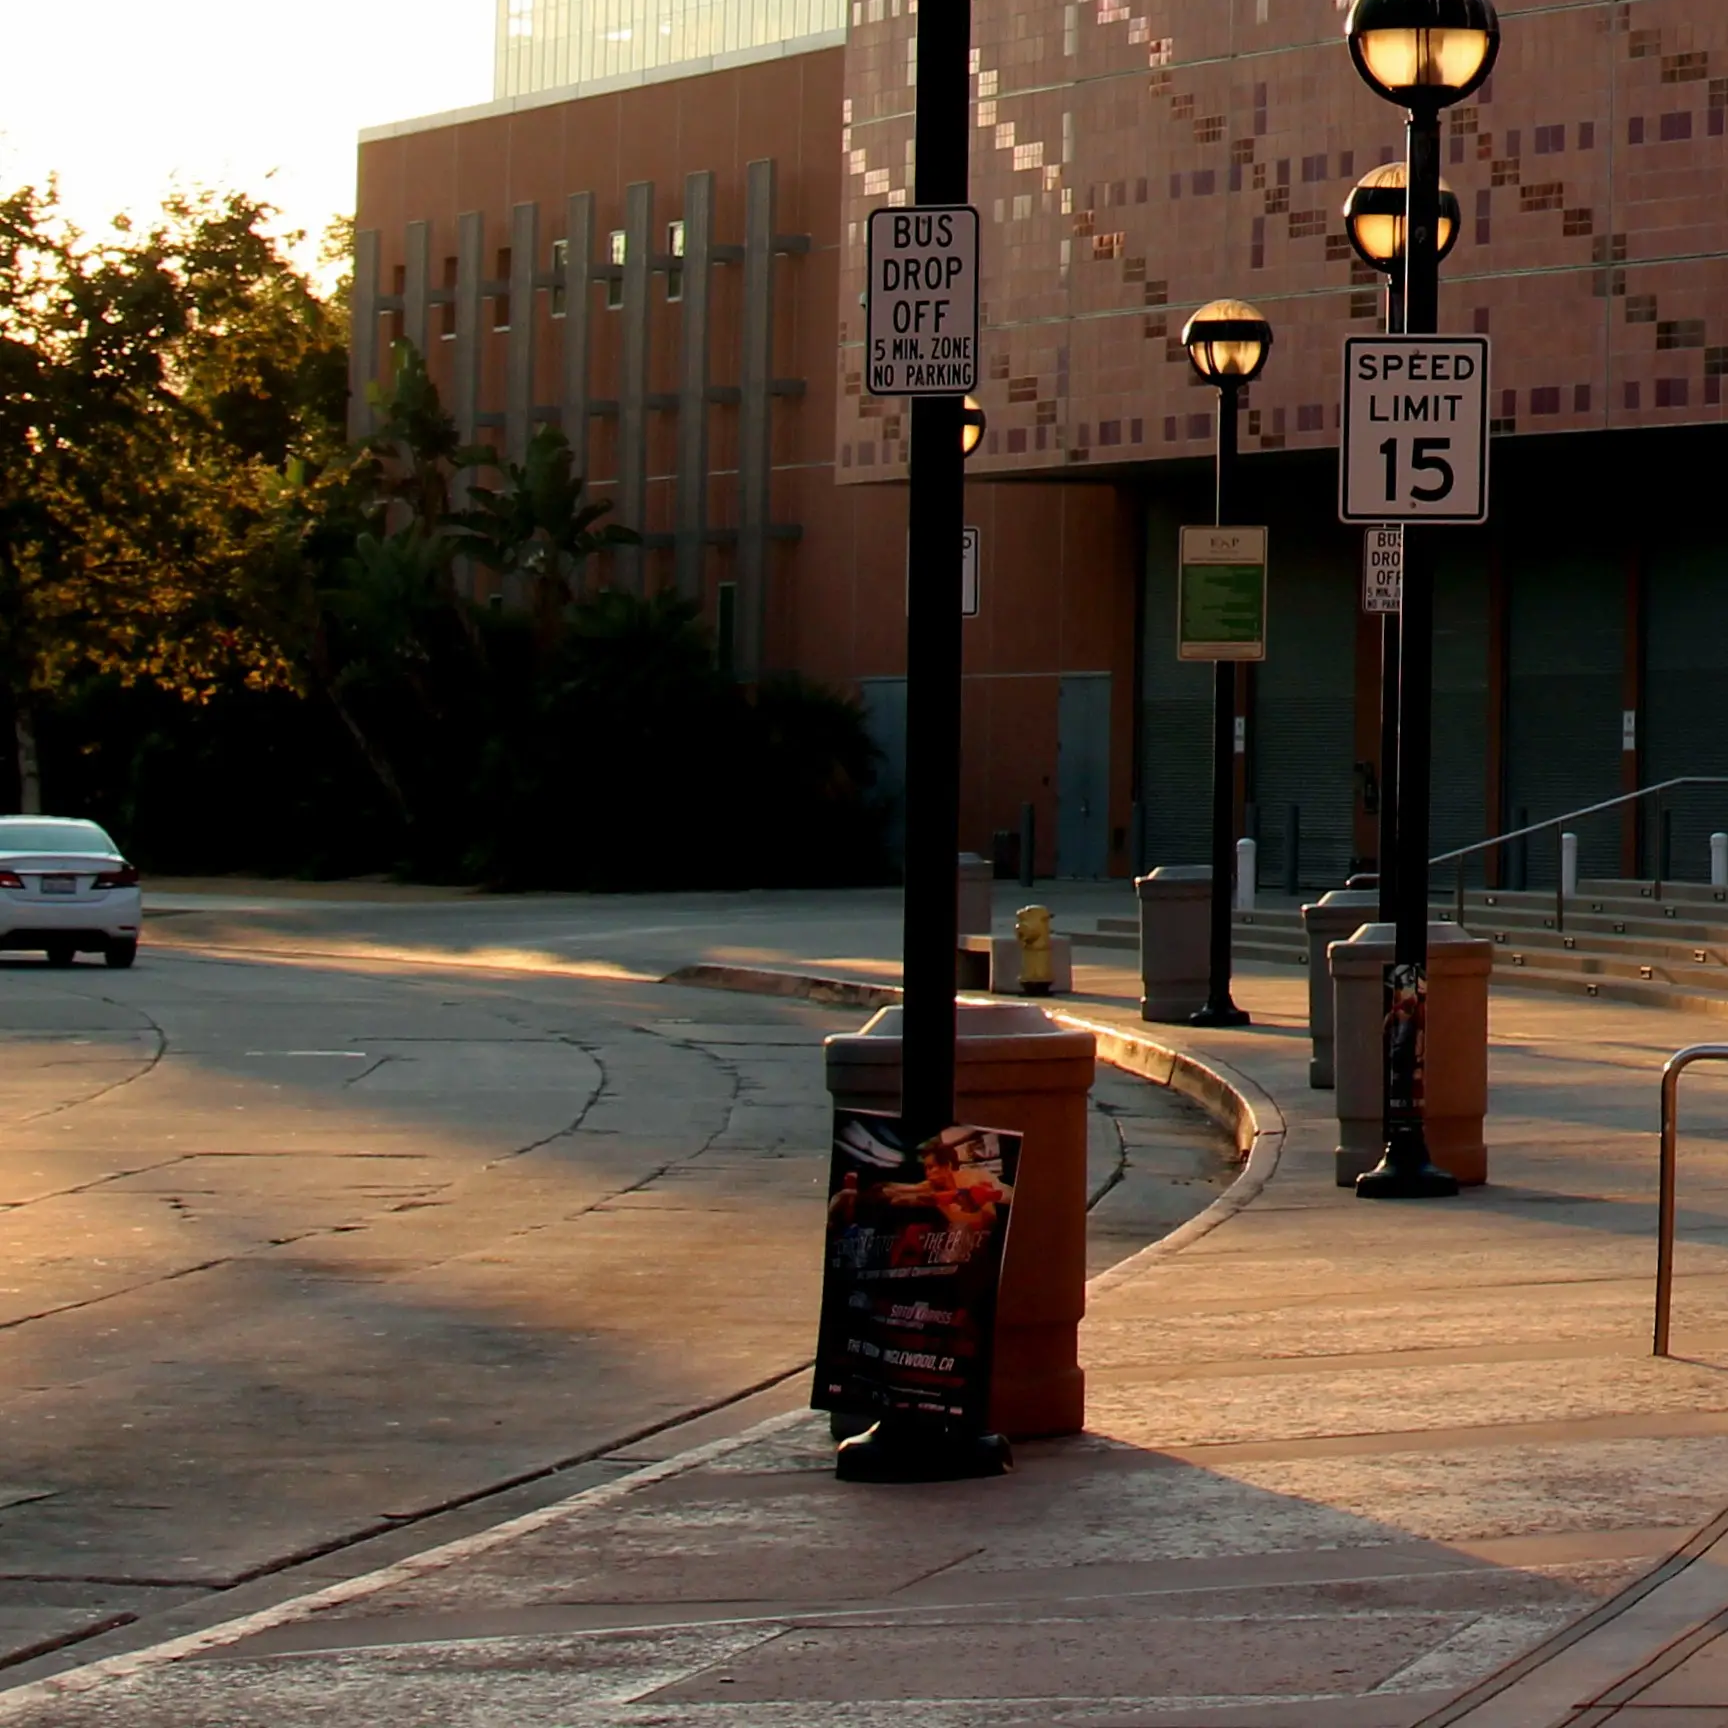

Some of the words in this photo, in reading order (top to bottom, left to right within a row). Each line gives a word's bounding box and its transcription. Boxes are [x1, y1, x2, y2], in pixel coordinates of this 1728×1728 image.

[894, 215, 953, 249] BUS
[883, 256, 962, 291] DROP
[893, 300, 949, 334] OFF
[875, 339, 886, 361] 5
[892, 338, 924, 360] MIN.
[931, 337, 971, 359] ZONE
[874, 365, 894, 387] NO
[906, 363, 971, 386] PARKING
[1358, 354, 1475, 381] SPEED
[1370, 395, 1463, 422] LIMIT
[1379, 437, 1454, 502] 15
[1372, 551, 1401, 566] DRO
